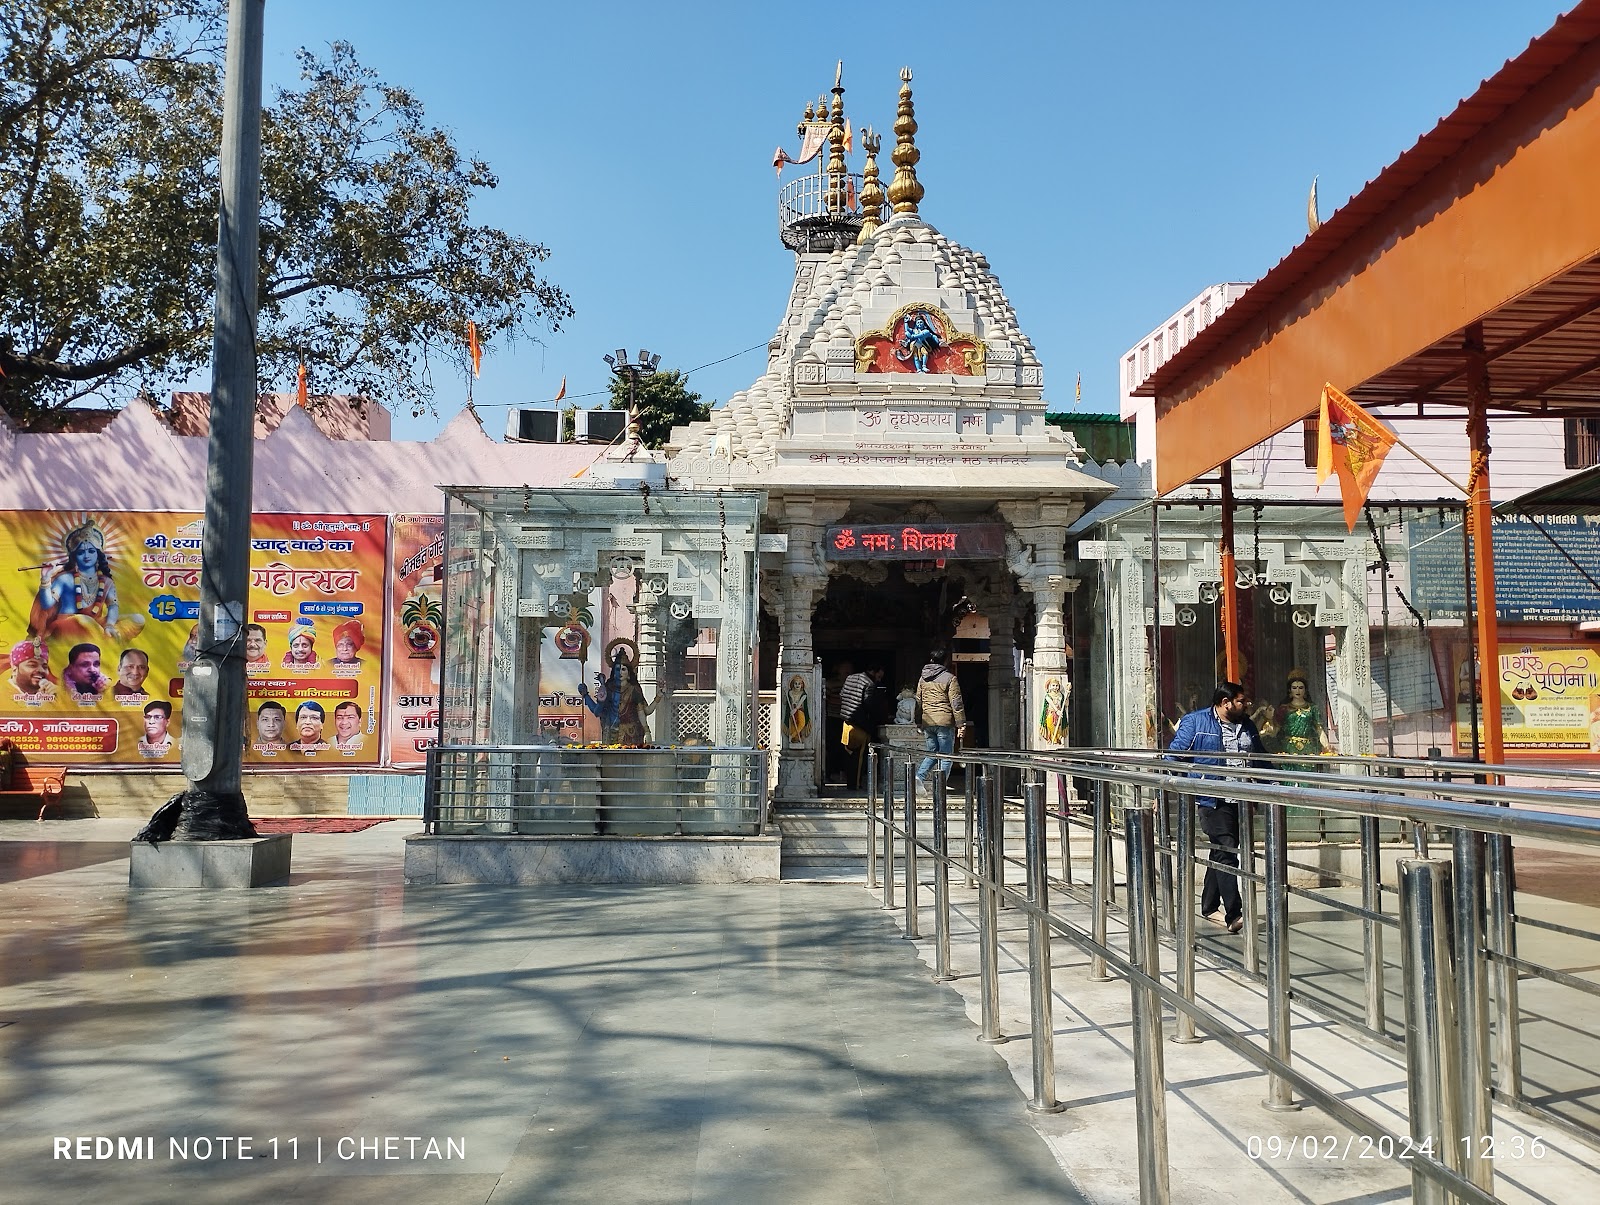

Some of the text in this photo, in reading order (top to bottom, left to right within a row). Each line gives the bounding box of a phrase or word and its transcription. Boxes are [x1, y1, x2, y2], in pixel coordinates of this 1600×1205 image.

[859, 411, 881, 427] ॐ
[890, 412, 953, 430] दूधेश्वराय
[809, 453, 830, 464] श्री
[962, 457, 982, 466] मठ
[145, 534, 354, 554] श्री श्या खाटू वाले का
[834, 527, 958, 551] ॐ नमः शिवाय
[142, 555, 155, 563] 15
[171, 553, 186, 564] श्री
[142, 563, 360, 595] वन्द महोत्सव
[157, 601, 177, 616] 15
[1532, 657, 1588, 694] पूर्णिमा
[258, 688, 291, 698] मैदान,
[294, 687, 351, 698] गाजियाबाद
[399, 695, 433, 707] आप
[43, 721, 109, 733] गाजियाबाद
